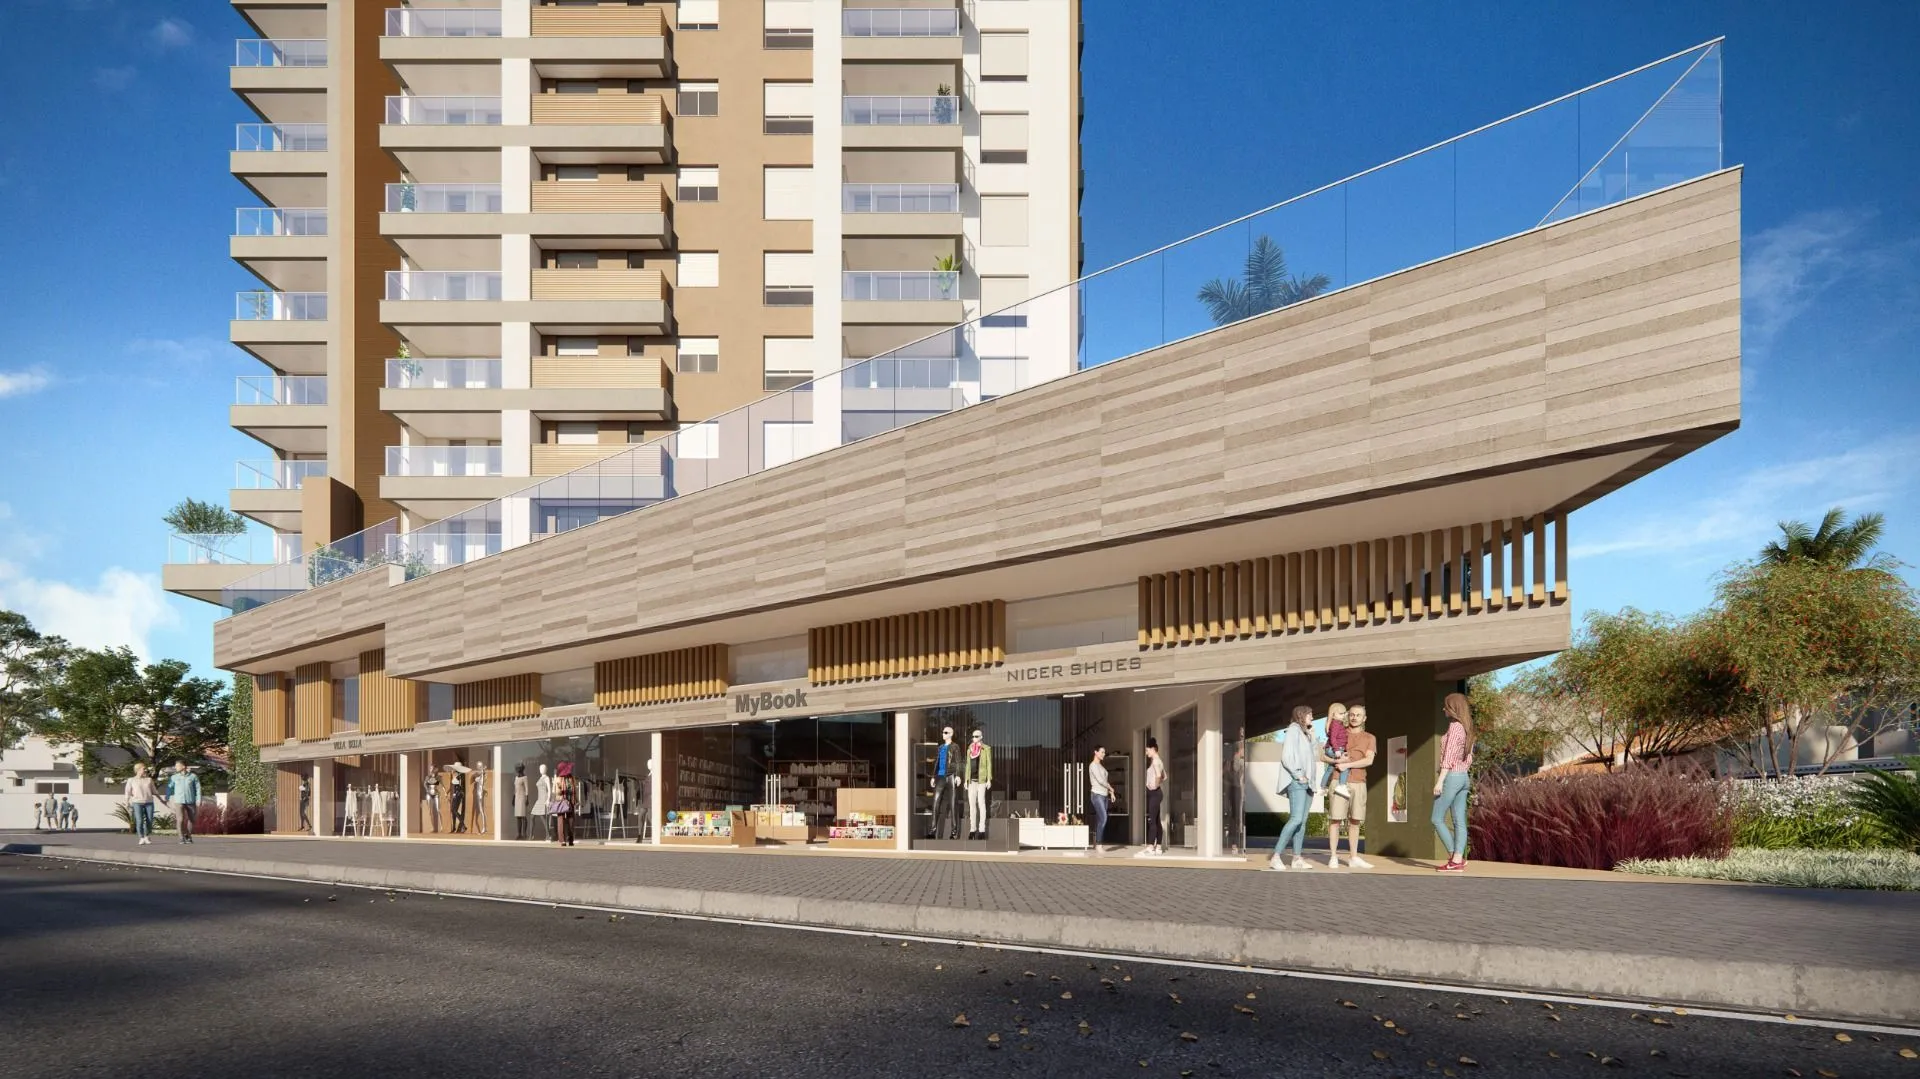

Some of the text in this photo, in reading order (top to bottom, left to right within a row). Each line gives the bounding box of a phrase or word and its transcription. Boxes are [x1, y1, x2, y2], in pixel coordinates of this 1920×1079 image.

[1007, 657, 1142, 682] NICER SHOES
[735, 688, 808, 716] MyBook
[541, 714, 602, 731] MARTA ROCHA
